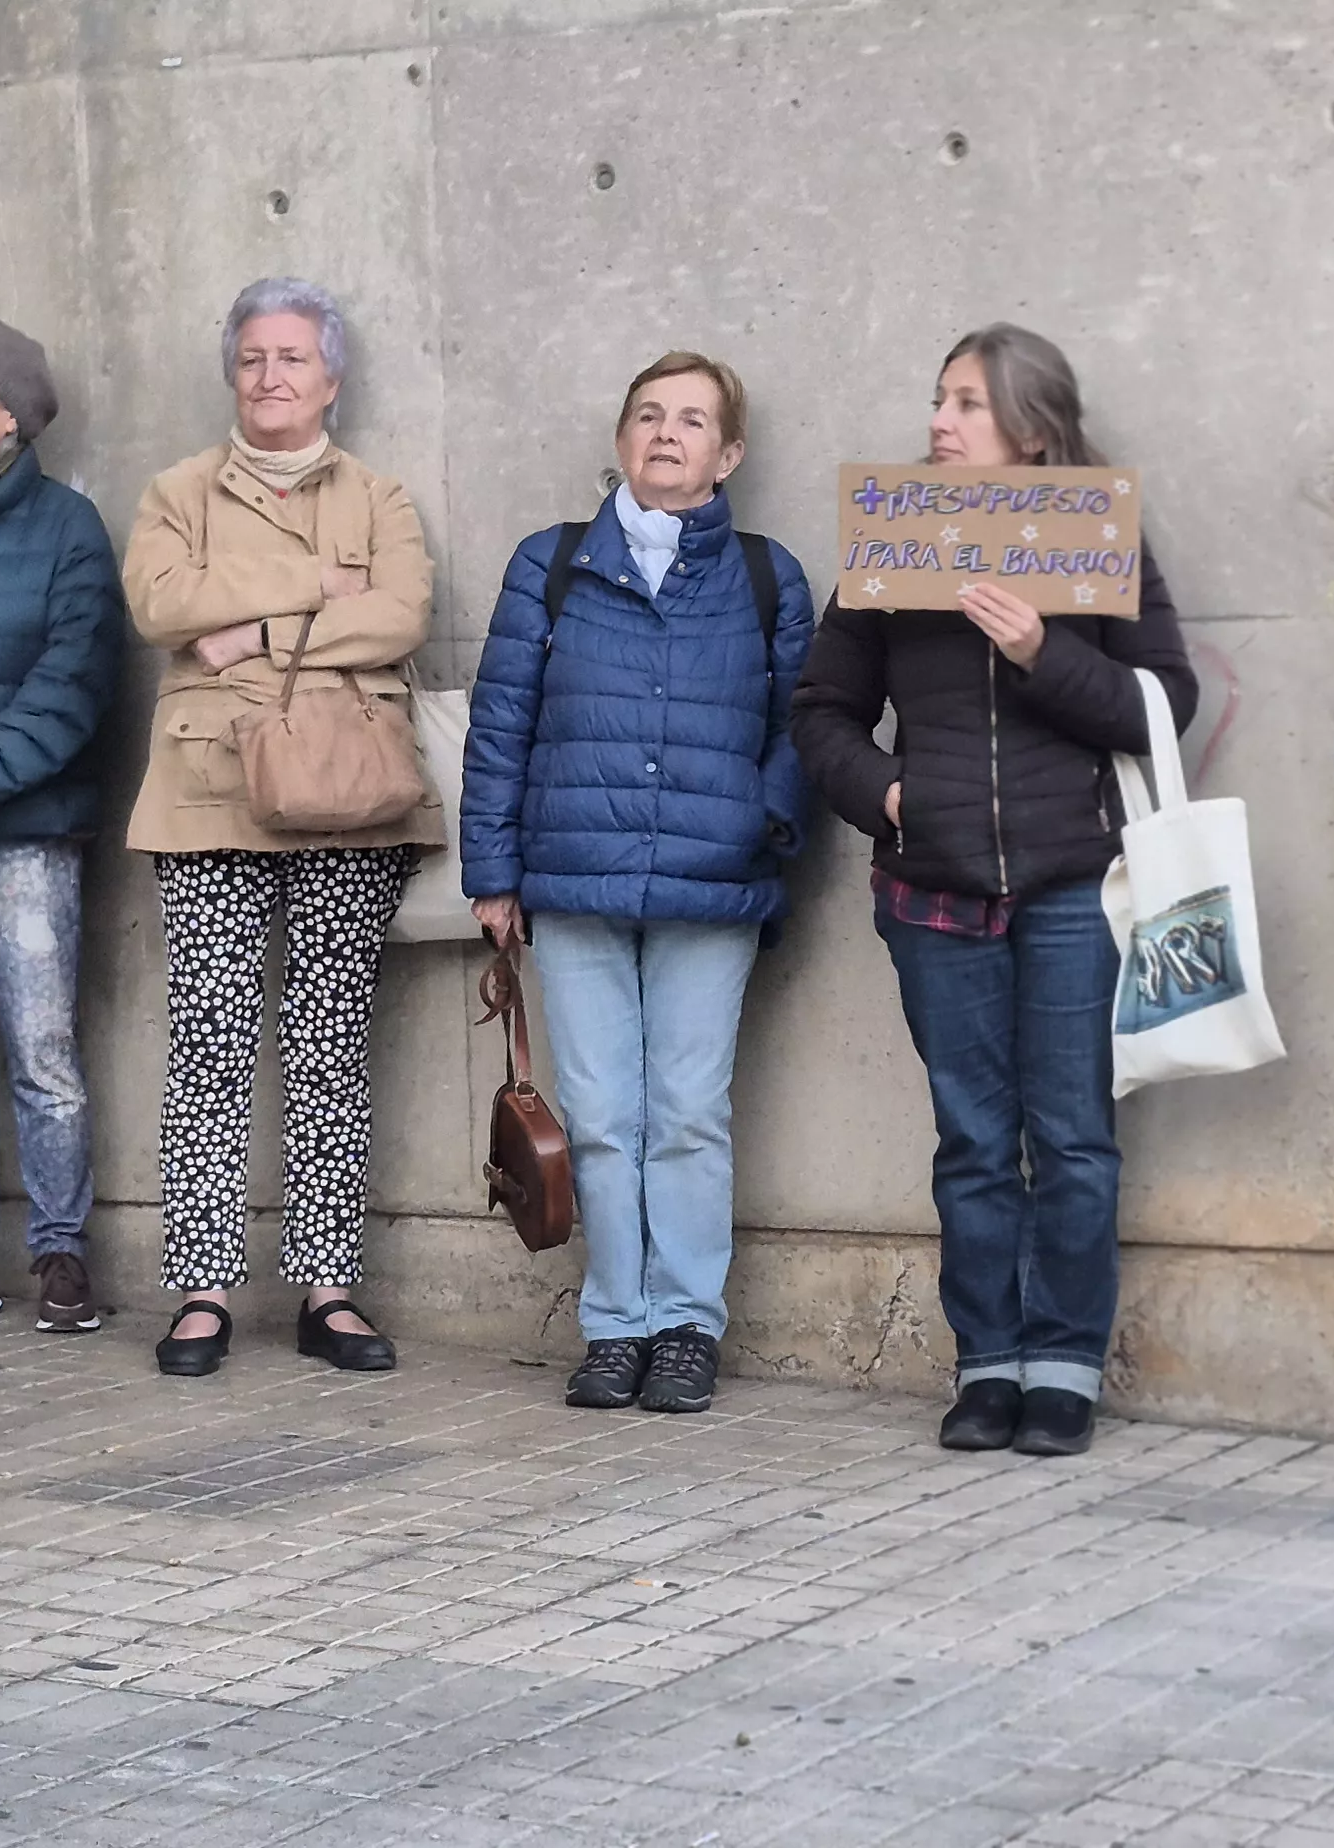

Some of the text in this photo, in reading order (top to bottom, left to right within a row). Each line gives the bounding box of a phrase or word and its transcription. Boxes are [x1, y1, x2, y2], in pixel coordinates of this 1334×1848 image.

[844, 527, 1137, 595] ¡PARA EL BARRIO!
